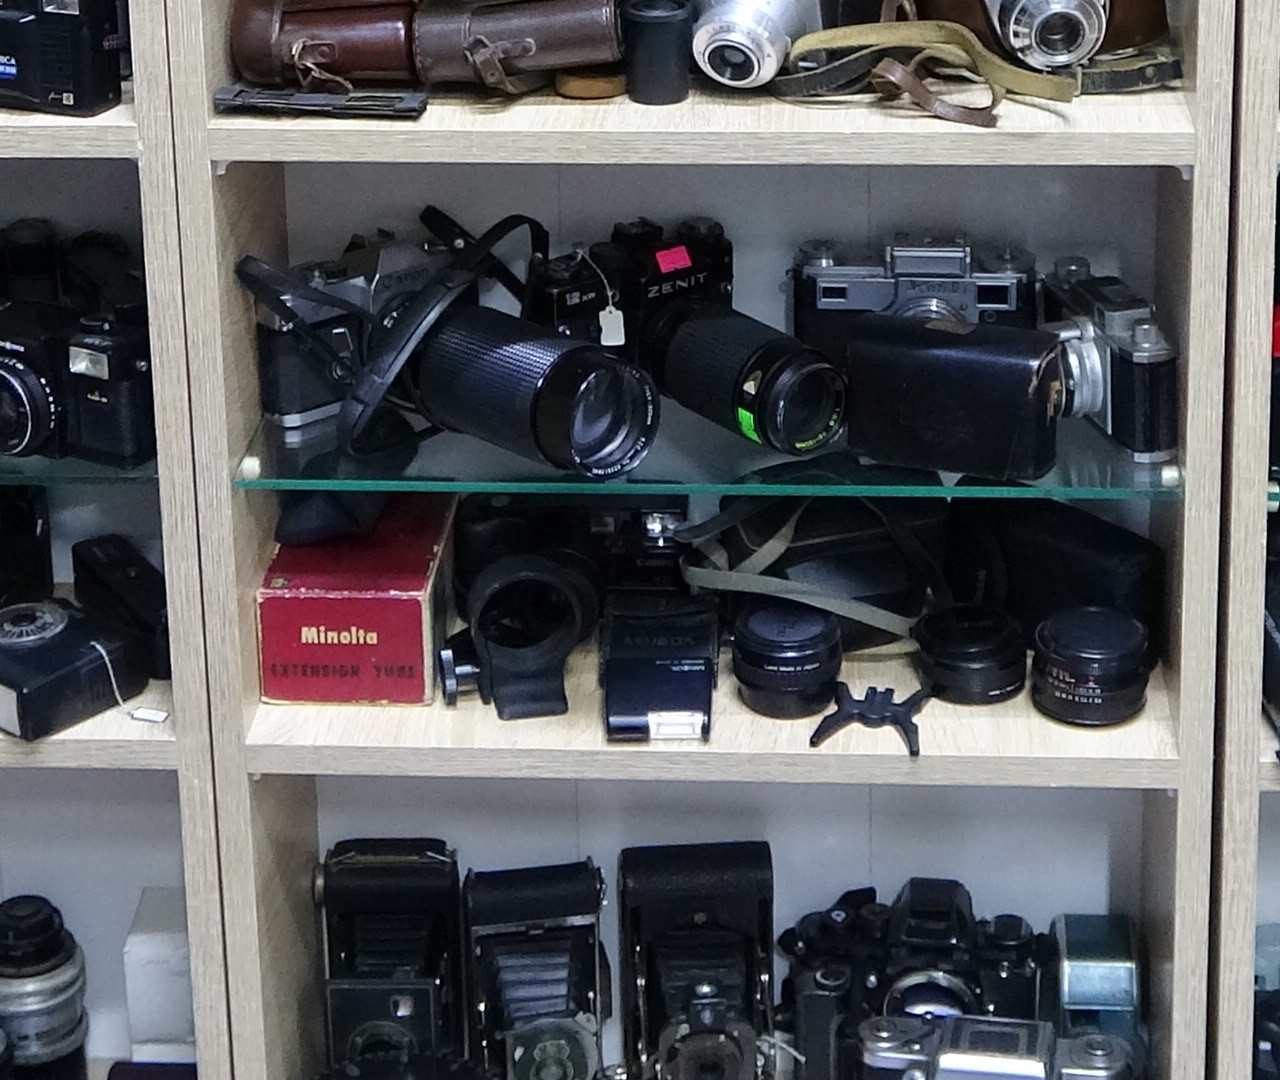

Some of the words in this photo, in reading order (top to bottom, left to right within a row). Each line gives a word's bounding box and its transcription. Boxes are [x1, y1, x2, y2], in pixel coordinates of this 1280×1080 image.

[647, 272, 708, 299] ZENIT
[301, 625, 378, 645] Minolta
[270, 664, 361, 679] EXTENSION
